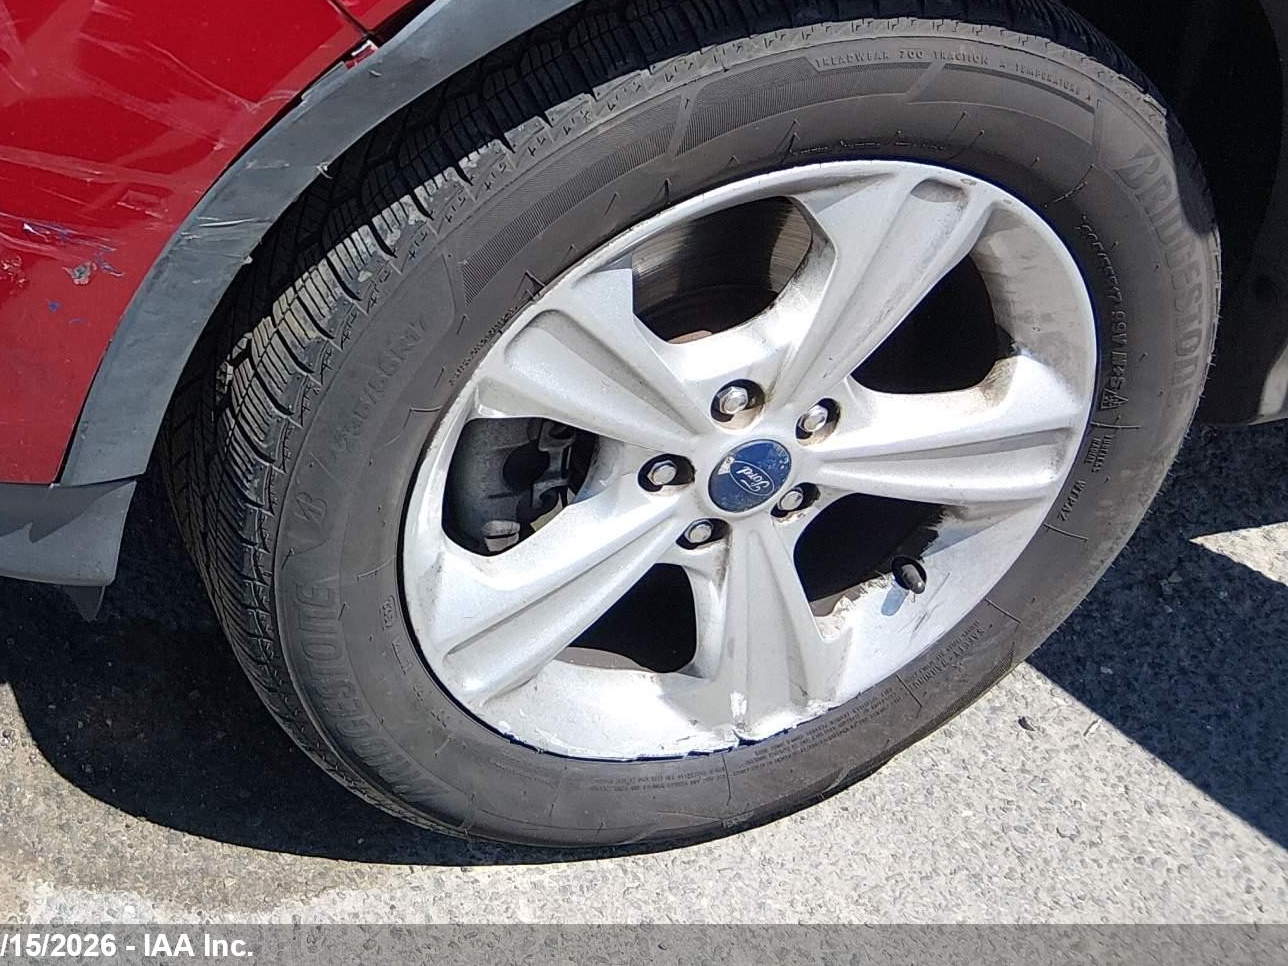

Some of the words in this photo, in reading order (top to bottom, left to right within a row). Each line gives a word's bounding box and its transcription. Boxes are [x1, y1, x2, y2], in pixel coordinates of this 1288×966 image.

[899, 49, 924, 60] 700
[1113, 143, 1204, 408] BRIDGESTONE
[735, 465, 770, 493] Ford
[292, 580, 446, 802] BRIDGESTONE
